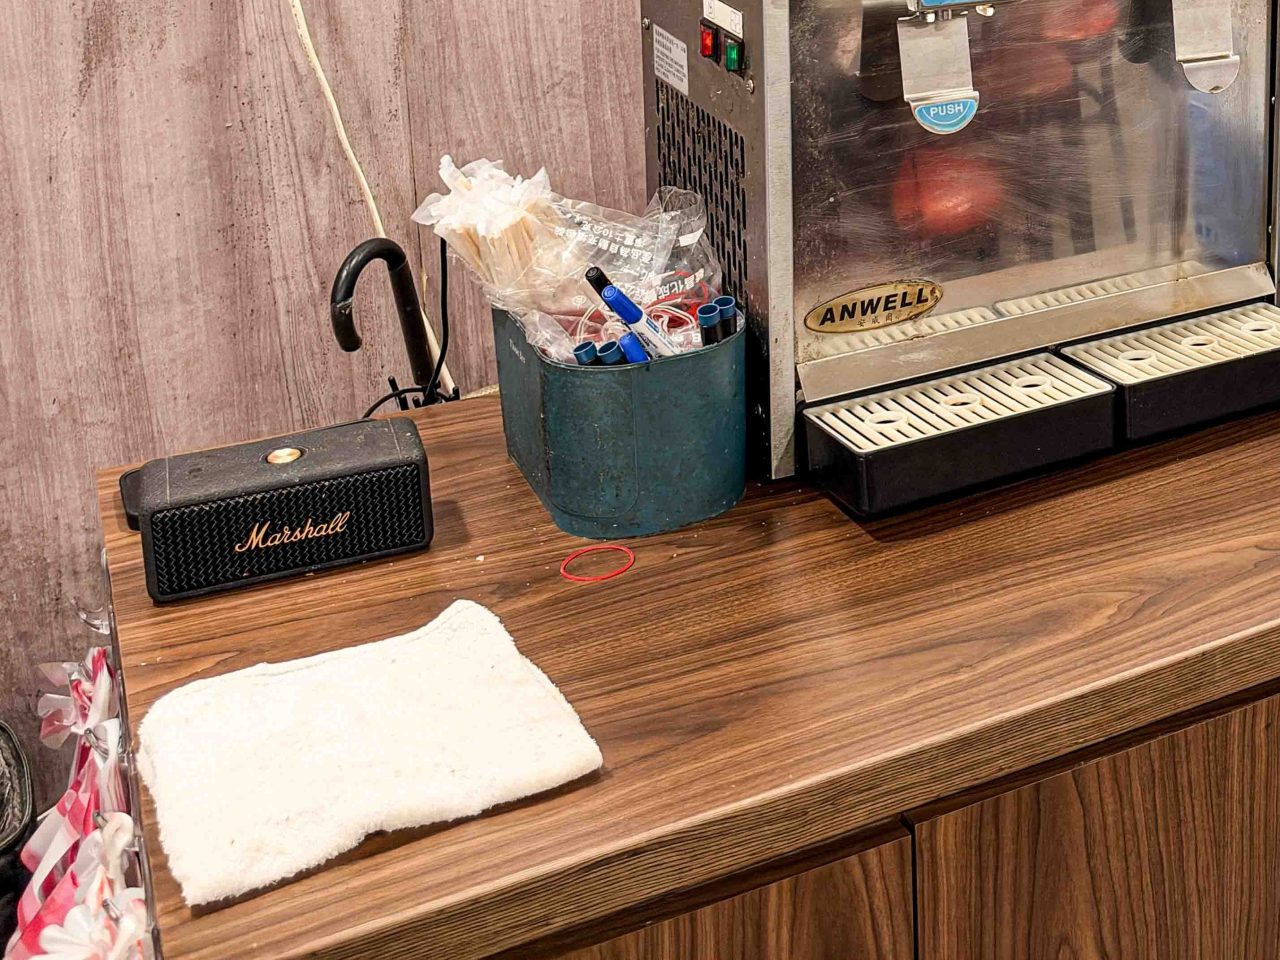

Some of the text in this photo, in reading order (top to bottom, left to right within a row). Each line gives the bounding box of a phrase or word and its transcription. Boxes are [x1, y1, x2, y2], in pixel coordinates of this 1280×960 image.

[929, 102, 965, 117] PUSH
[819, 287, 929, 326] ANWELL
[234, 510, 351, 553] Marshall
